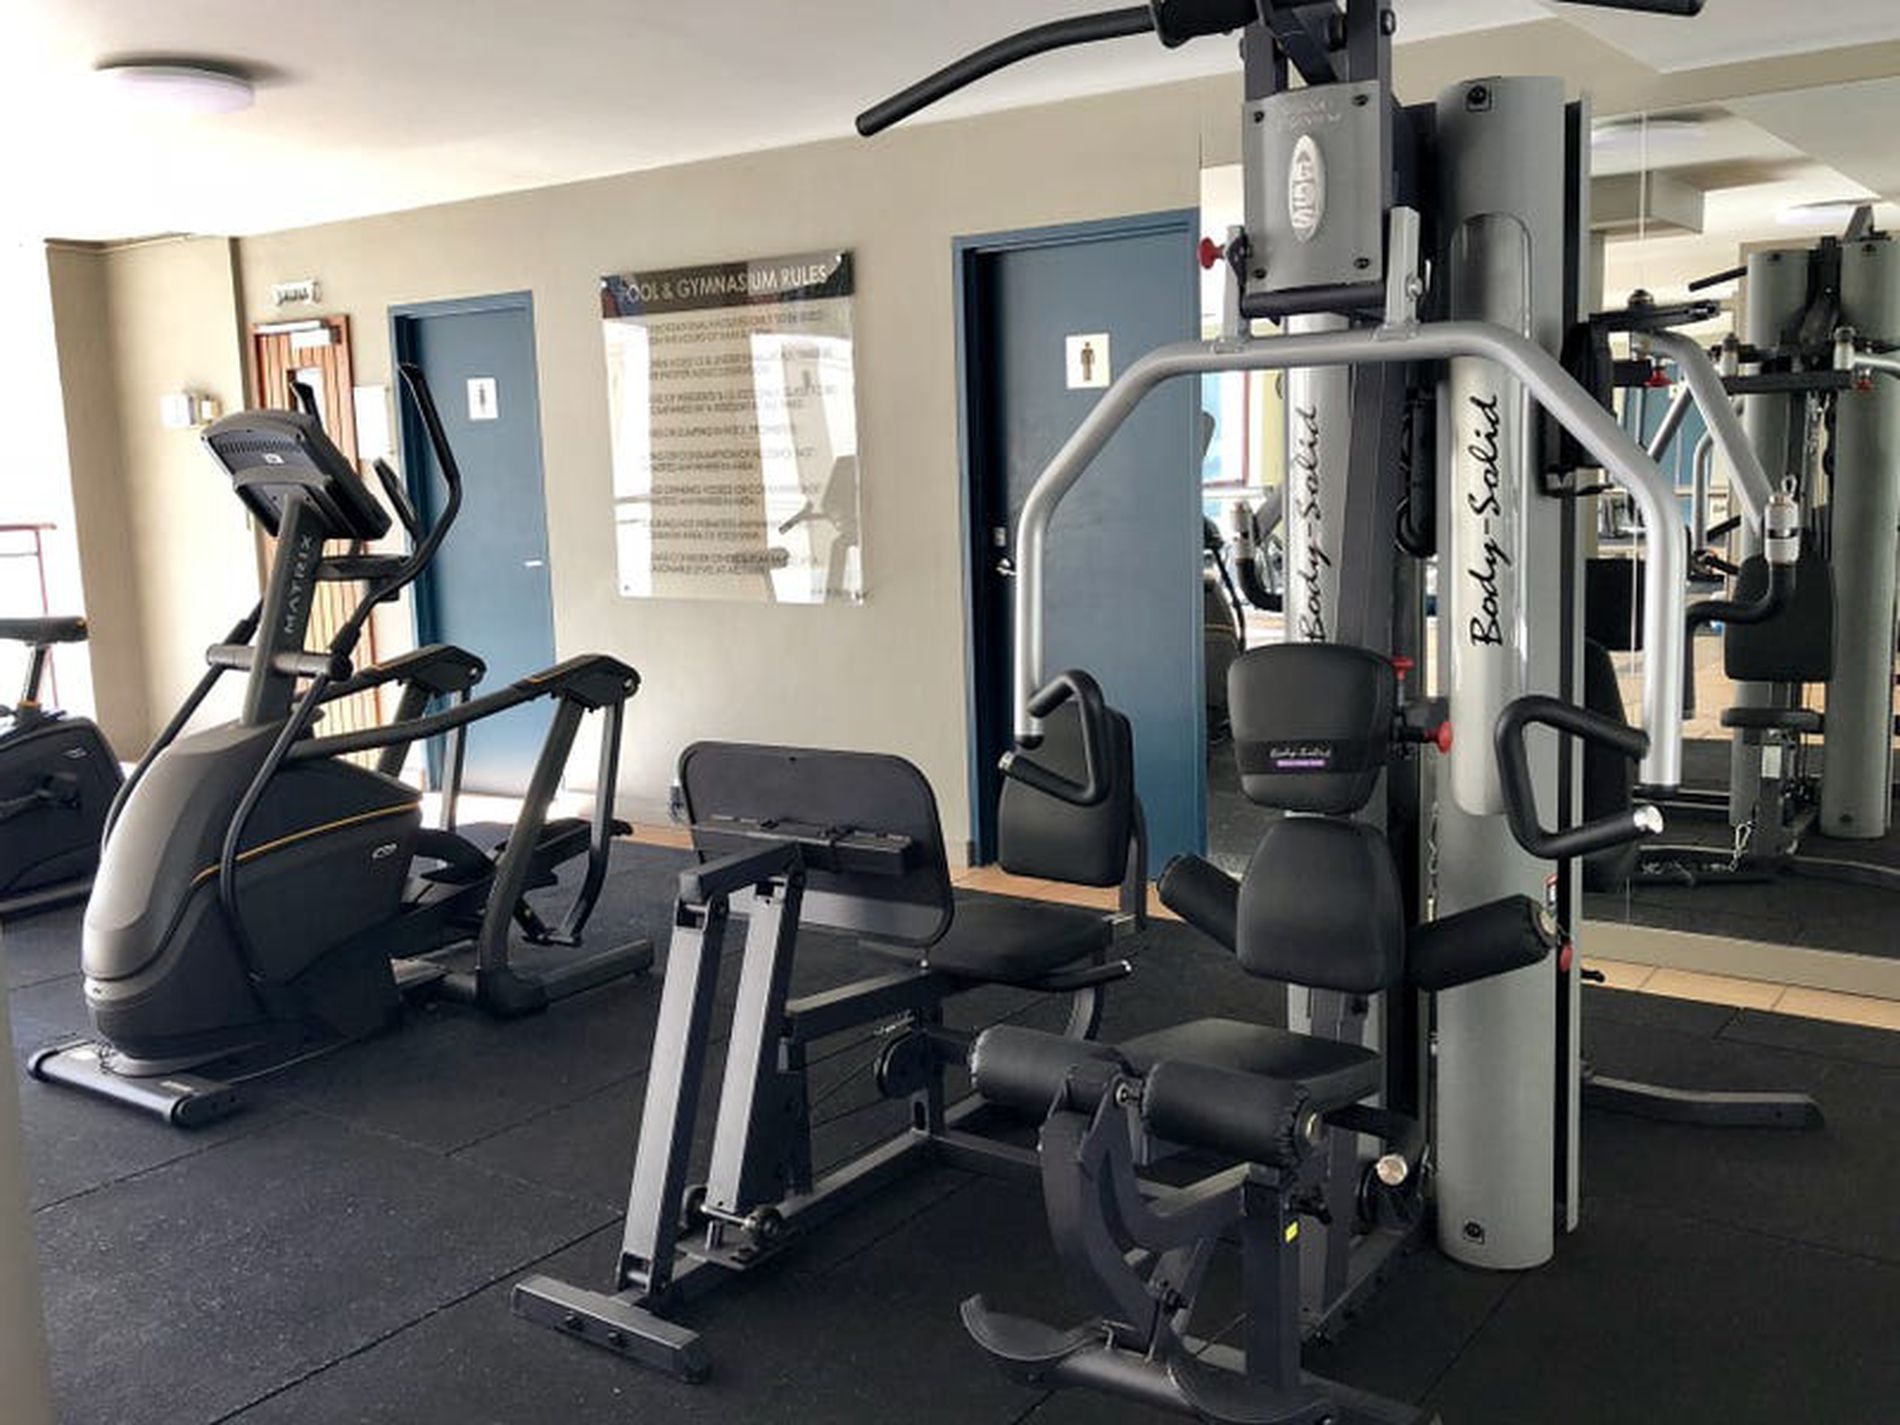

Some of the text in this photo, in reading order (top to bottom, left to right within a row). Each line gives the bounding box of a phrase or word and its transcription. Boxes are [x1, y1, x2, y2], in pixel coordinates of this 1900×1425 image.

[780, 264, 828, 289] RULES
[284, 535, 313, 633] MATRIX
[1295, 405, 1331, 642] Body-Solid
[1468, 395, 1511, 646] Body-Solid
